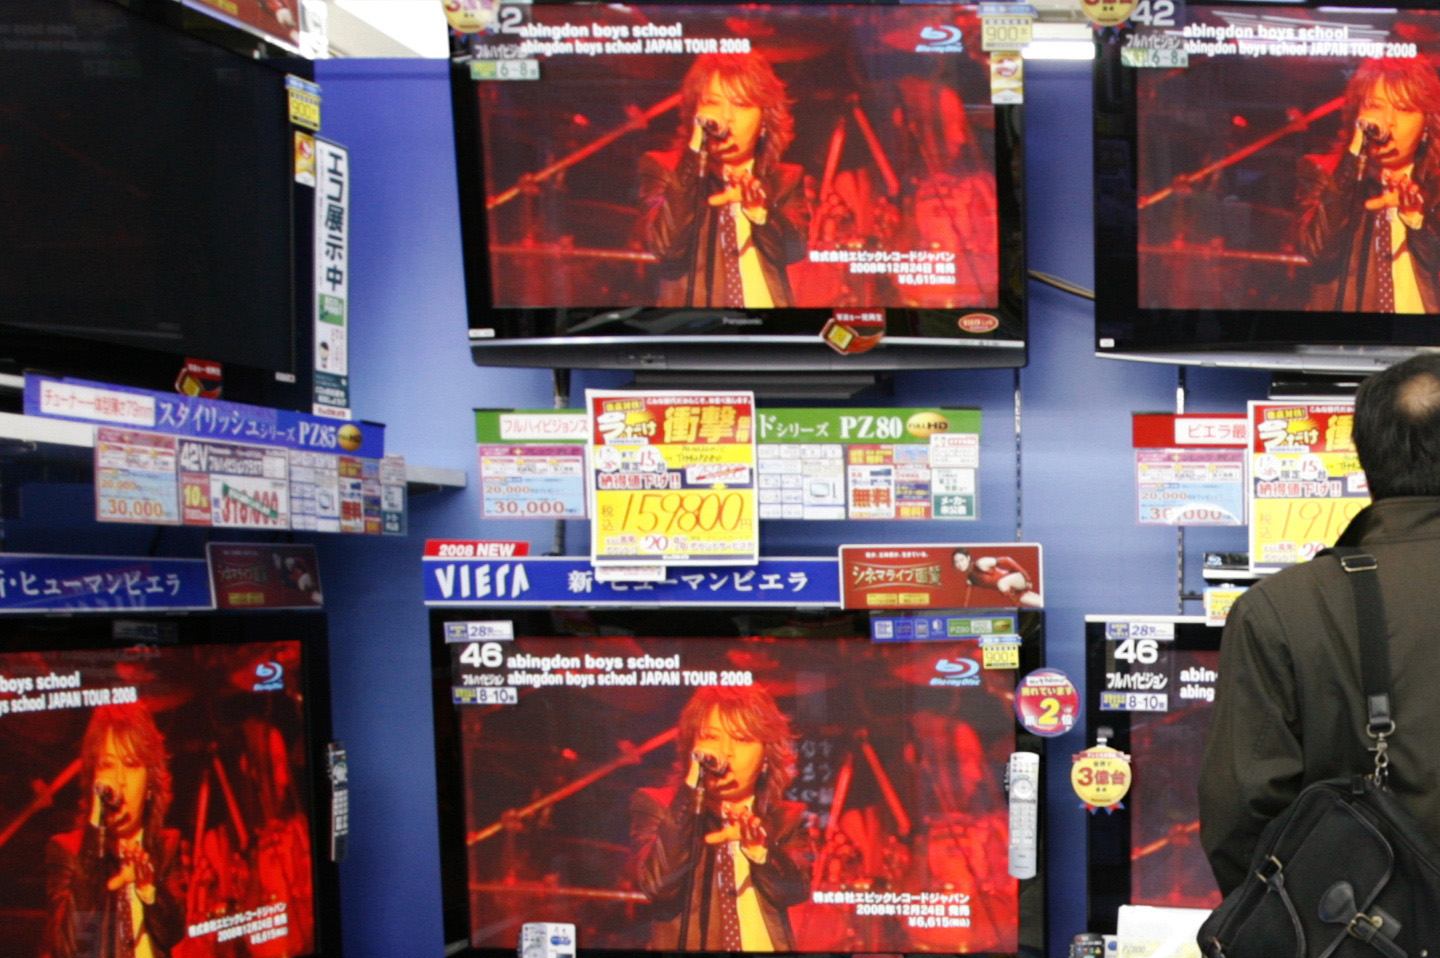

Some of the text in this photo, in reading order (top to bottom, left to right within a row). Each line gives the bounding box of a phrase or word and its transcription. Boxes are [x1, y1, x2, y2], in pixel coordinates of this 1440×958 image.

[519, 23, 682, 40] abingdon boys school
[1183, 24, 1349, 41] abingdon boys school
[520, 38, 750, 56] abingdon boys school JAPAN TOUR 2008
[1184, 41, 1237, 56] abingdon
[1239, 42, 1268, 57] boys
[1386, 43, 1418, 58] 2008
[325, 151, 344, 292] エコ展示中
[159, 401, 337, 446] スタイリッシュシリーズ PZ85
[663, 406, 736, 443] 衝撃
[839, 415, 902, 440] PZ80
[108, 499, 163, 516] 30,000
[494, 501, 565, 517] 30,000
[438, 543, 517, 557] 2008 NEW
[434, 564, 531, 599] VIERA
[459, 642, 503, 668] 46
[1113, 638, 1159, 664] 46
[507, 654, 680, 671] abingdon boys school
[36, 670, 81, 691] school
[507, 671, 753, 688] abingdon boys school JAPAN TOUR 2008
[1106, 672, 1168, 690] フルハイビジョン
[11, 686, 138, 714] school JAPAN TOUR 2008
[1077, 767, 1126, 787] 3億台
[812, 891, 970, 904] 株式会社エピックレコードジャパン
[856, 904, 945, 917] 2008年12月24日
